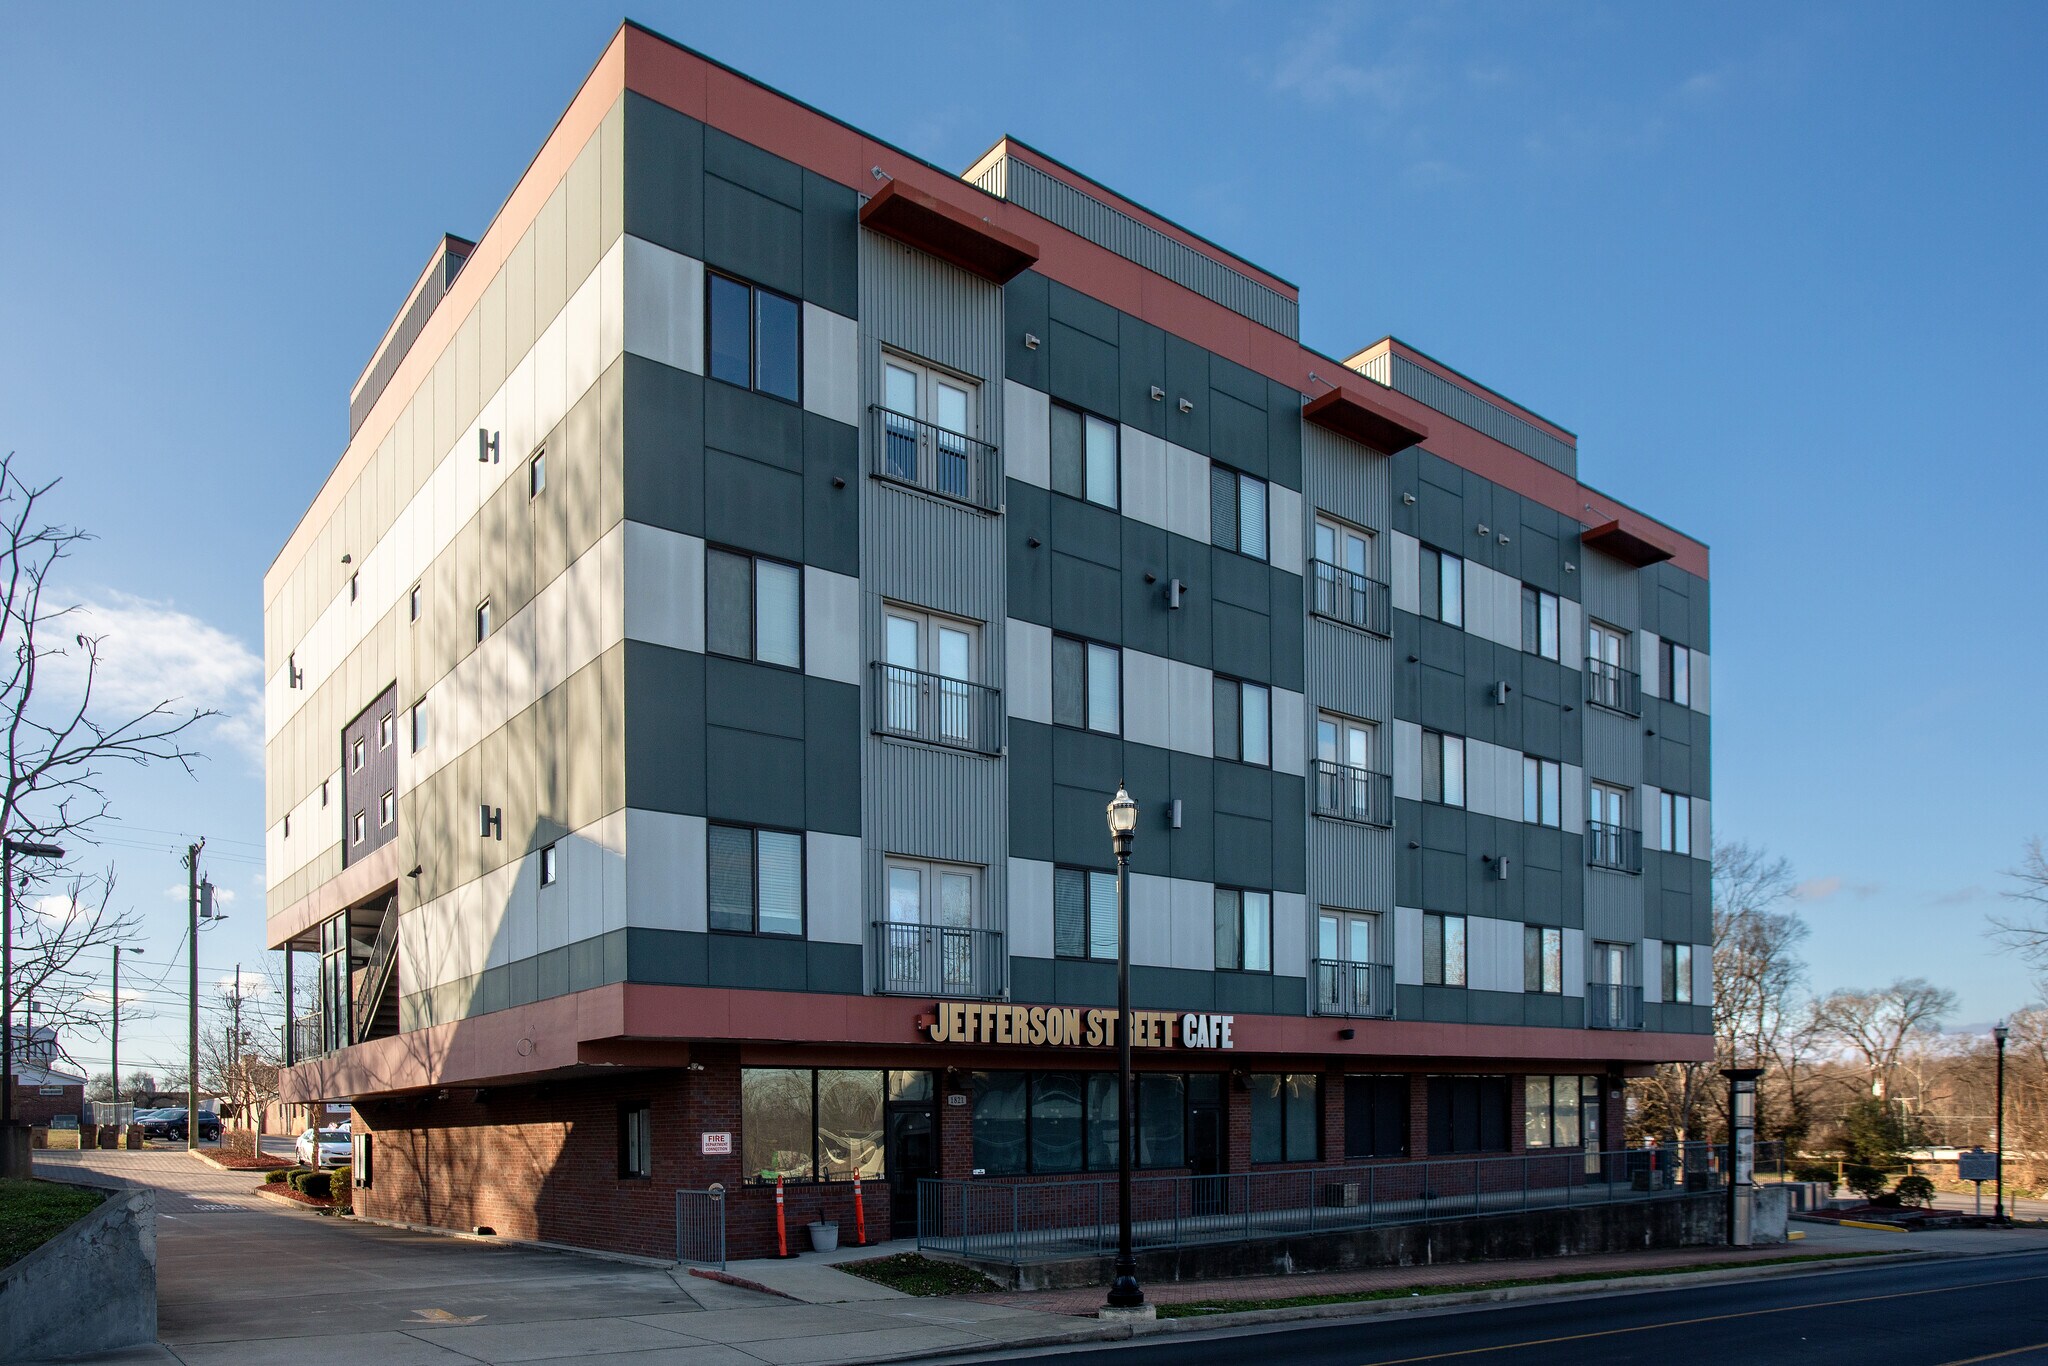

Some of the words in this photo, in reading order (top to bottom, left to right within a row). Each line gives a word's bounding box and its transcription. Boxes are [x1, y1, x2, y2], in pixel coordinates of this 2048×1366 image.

[930, 1002, 1080, 1045] JEFFERSON
[1086, 1009, 1177, 1047] STEET
[1182, 1013, 1234, 1049] CAFE
